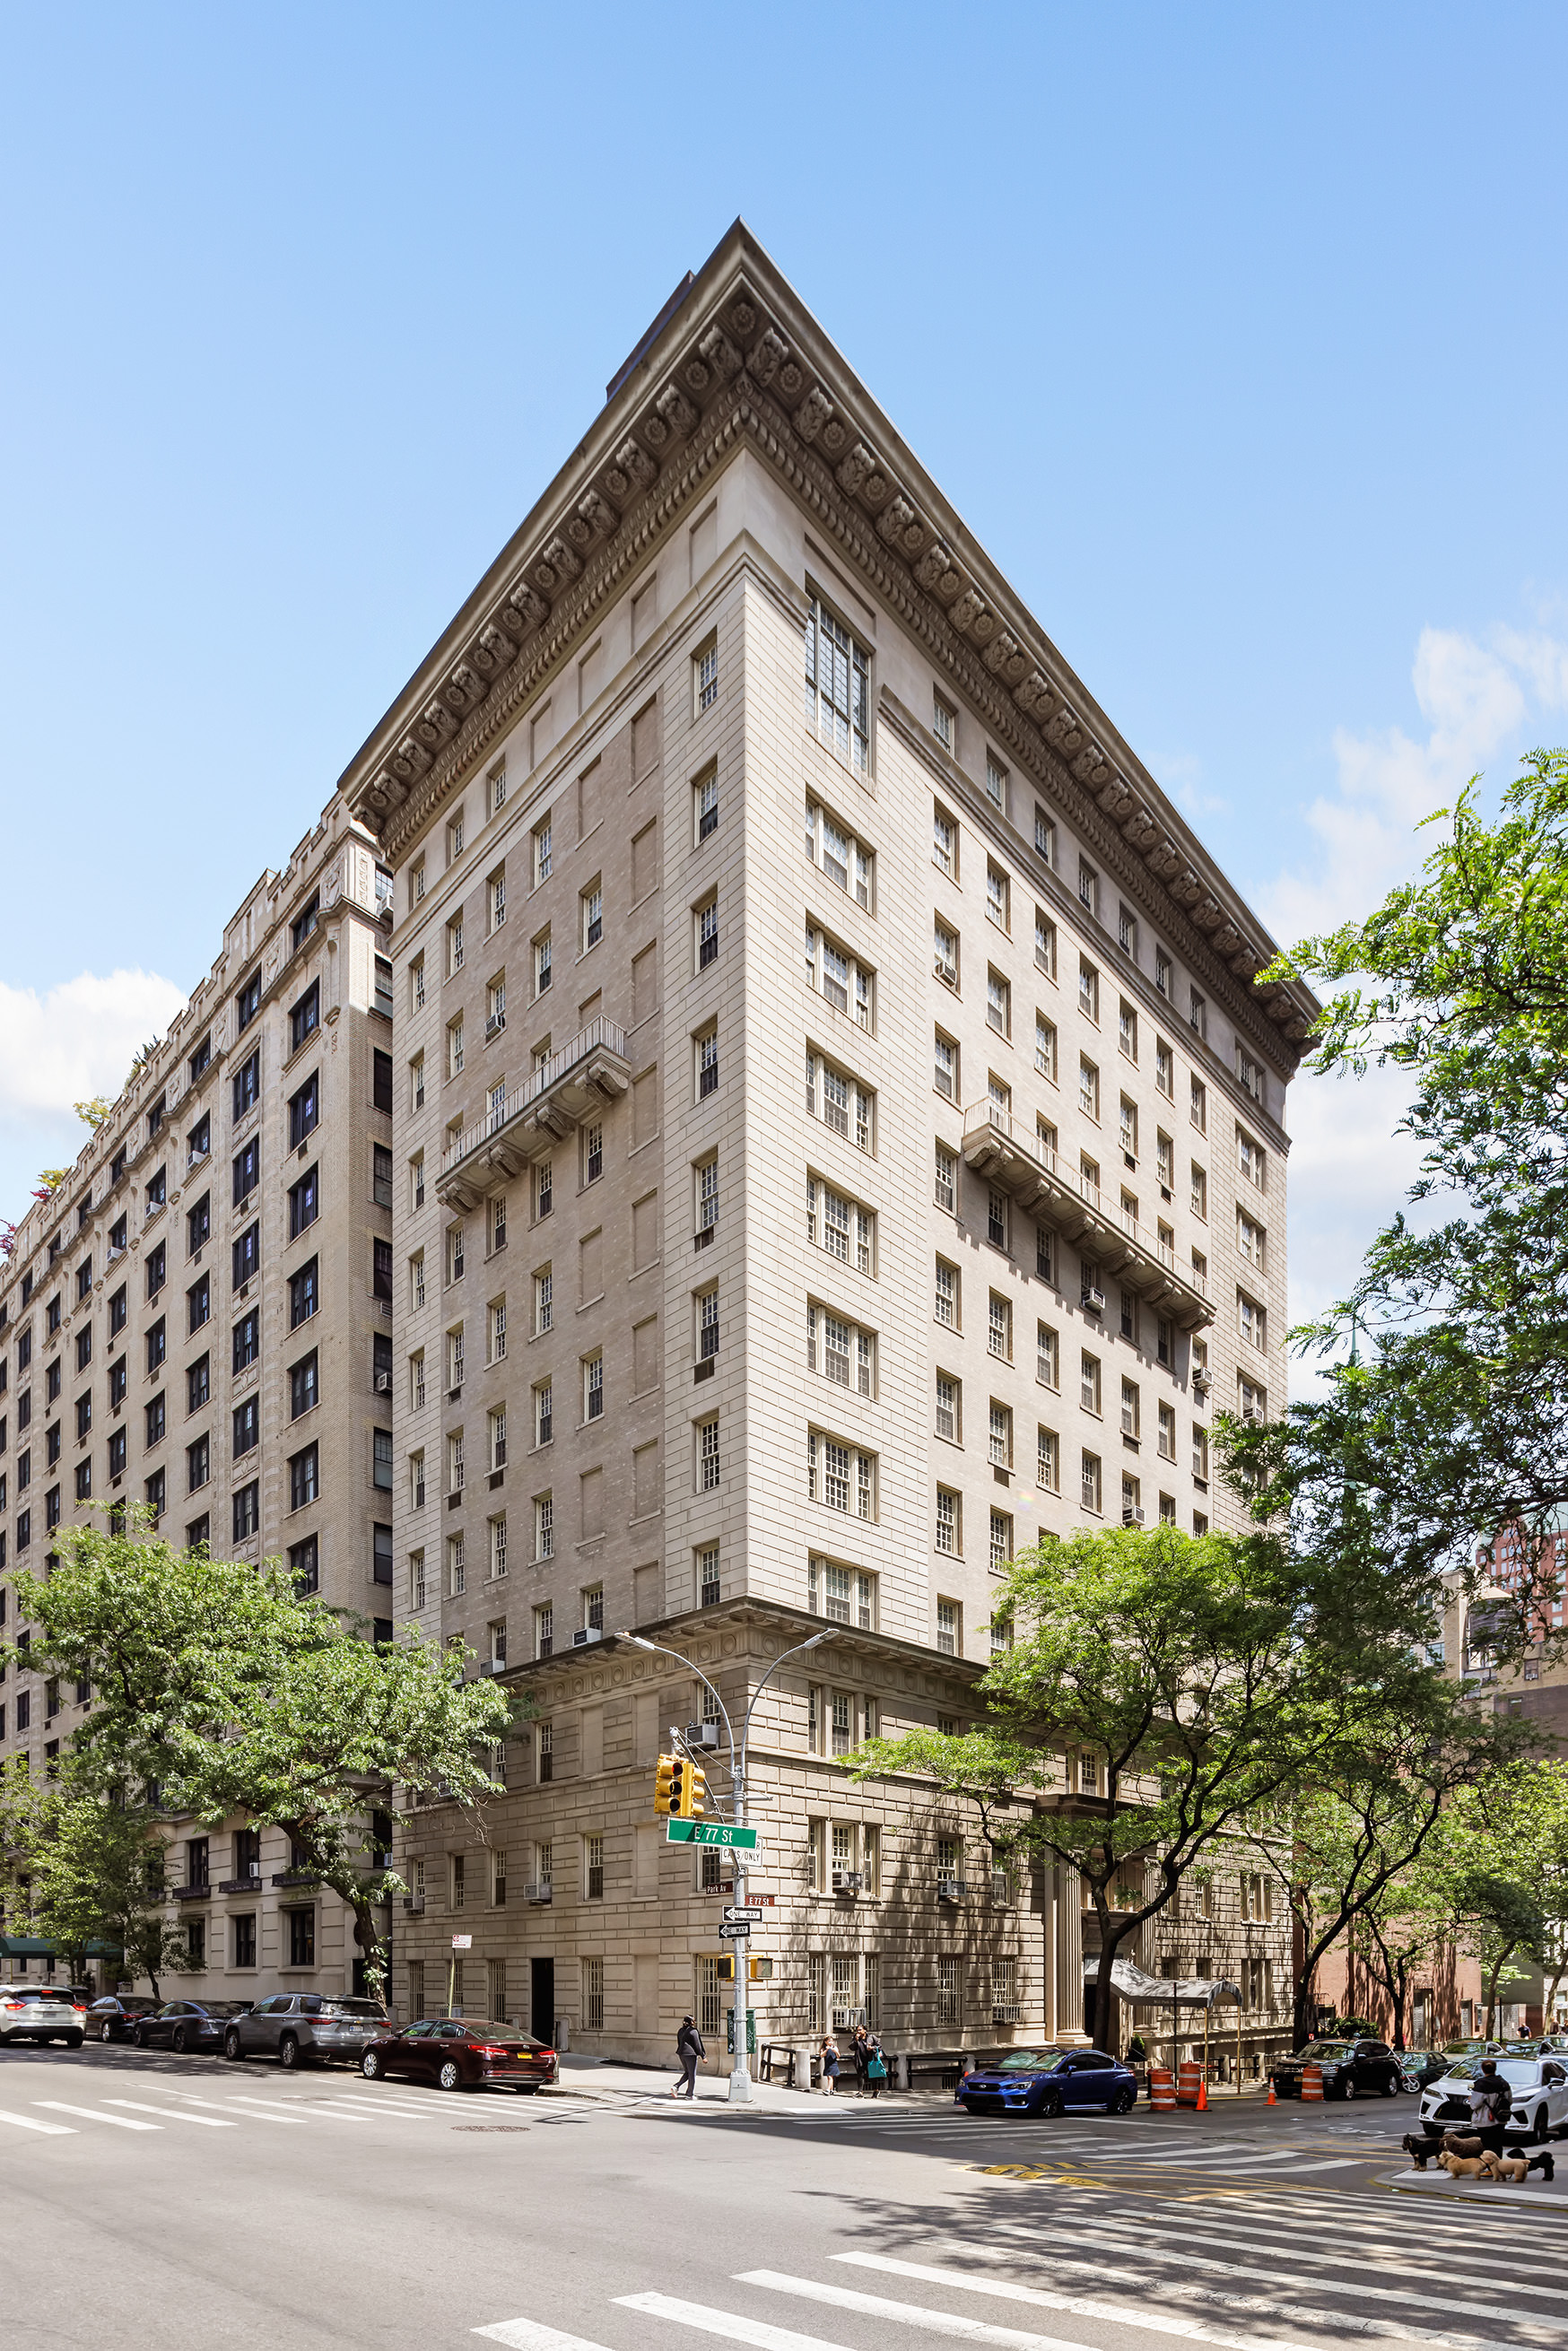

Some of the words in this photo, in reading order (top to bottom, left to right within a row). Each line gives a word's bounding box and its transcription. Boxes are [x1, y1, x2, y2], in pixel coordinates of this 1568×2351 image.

[694, 1826, 701, 1840] E
[705, 1827, 719, 1842] 77
[721, 1829, 733, 1843] St
[745, 1851, 760, 1862] ONLY
[707, 1885, 719, 1894] Park
[719, 1885, 727, 1893] Av
[754, 1897, 762, 1905] 77
[762, 1897, 770, 1906] St
